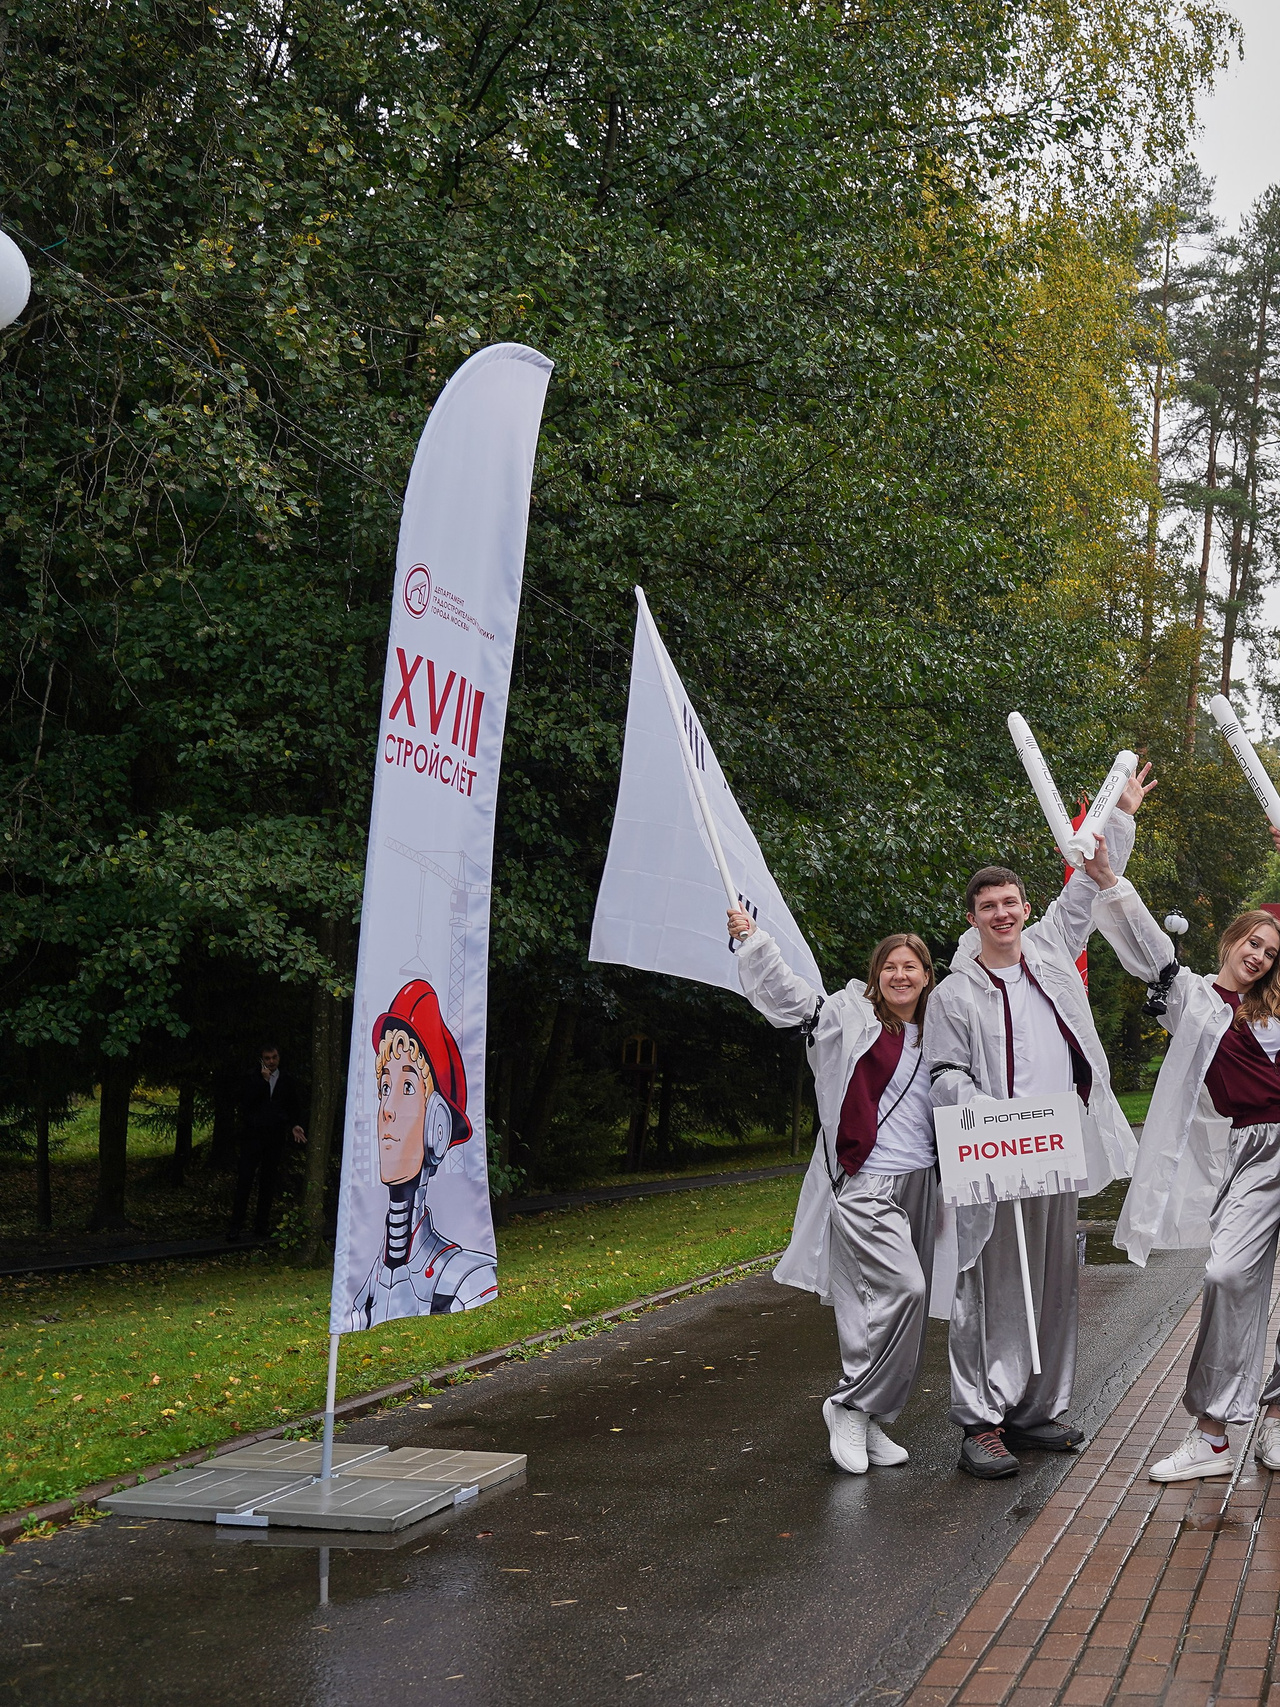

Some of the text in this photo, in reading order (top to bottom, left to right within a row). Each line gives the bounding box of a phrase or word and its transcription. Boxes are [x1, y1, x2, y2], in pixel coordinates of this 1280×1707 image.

[434, 586, 465, 607] ДЕПАРТАМЕНТ
[431, 605, 450, 620] ГОРОДА
[384, 733, 477, 797] СТРОЙСЛЁТ
[1232, 744, 1269, 808] PIONEER
[1091, 775, 1119, 818] PIONEER
[983, 1108, 1055, 1125] PIONEER
[958, 1133, 1065, 1162] PIONEER
